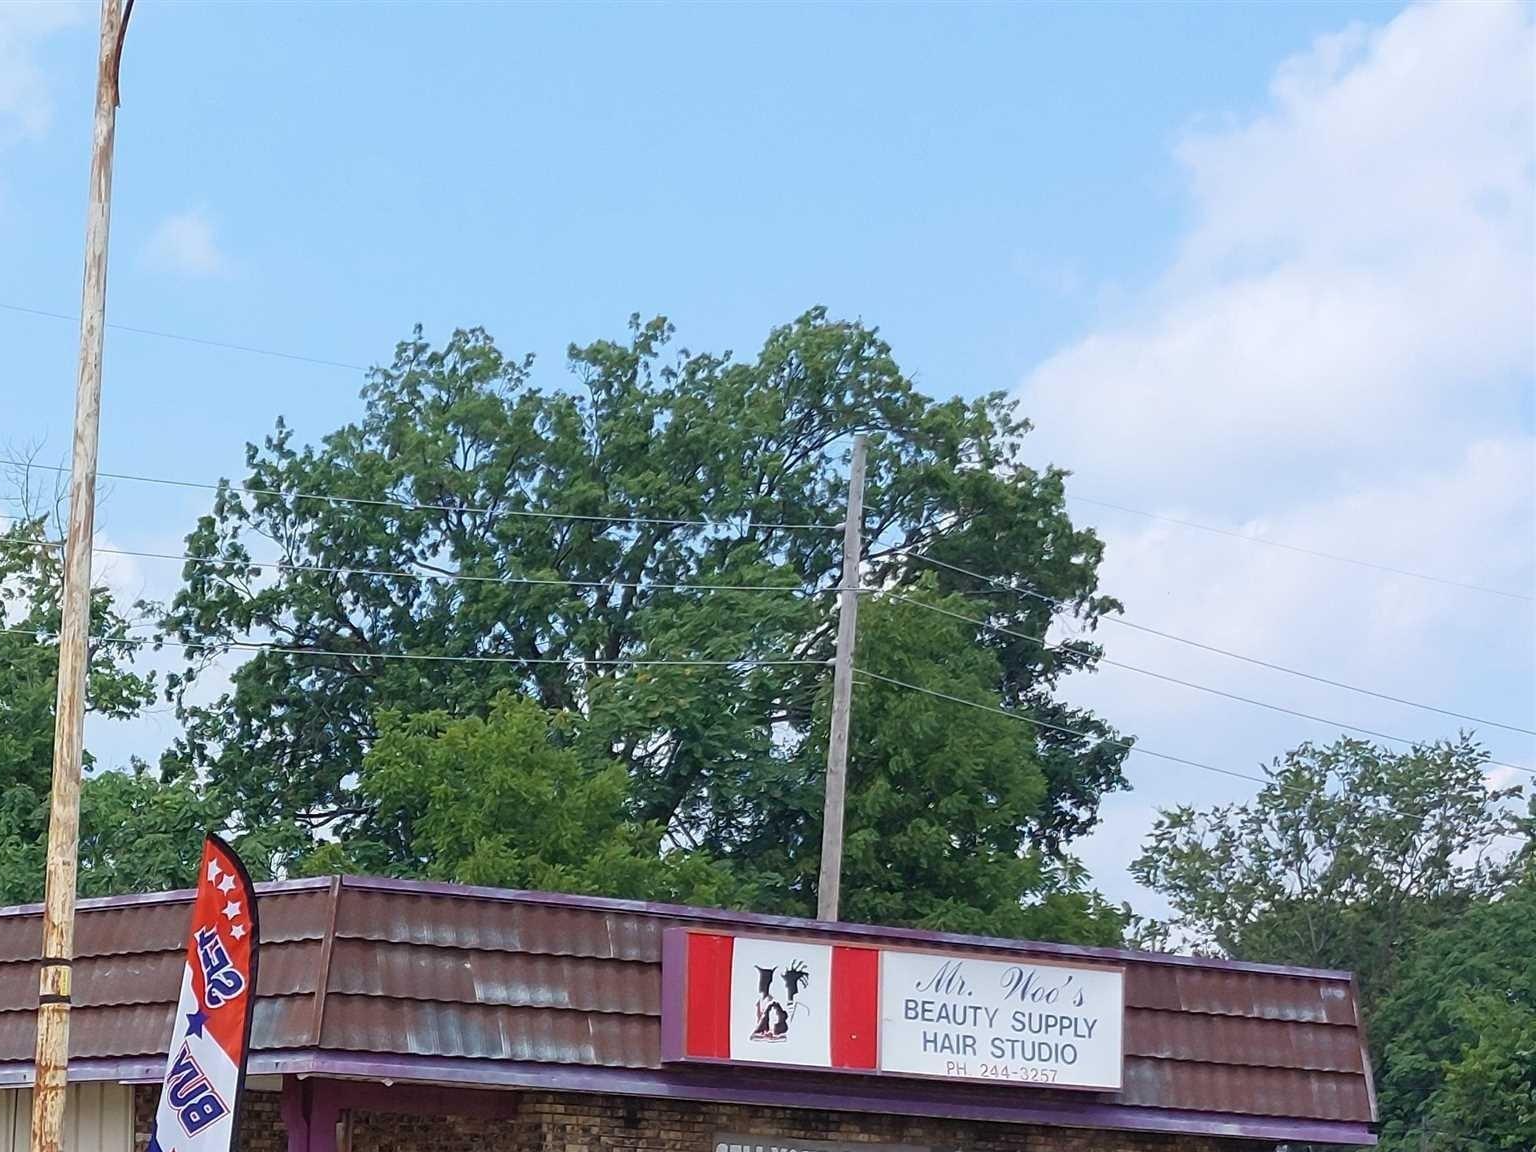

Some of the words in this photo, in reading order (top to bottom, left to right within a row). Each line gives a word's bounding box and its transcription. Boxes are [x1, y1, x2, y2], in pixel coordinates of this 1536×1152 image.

[915, 959, 973, 997] Mr.
[999, 966, 1084, 1007] Woo's
[904, 998, 999, 1029] BEAUTY
[1011, 1010, 1098, 1039] SUPPLY
[922, 1030, 978, 1056] HAIR
[990, 1037, 1078, 1065] STUDIO
[980, 1063, 1058, 1082] 244-3257
